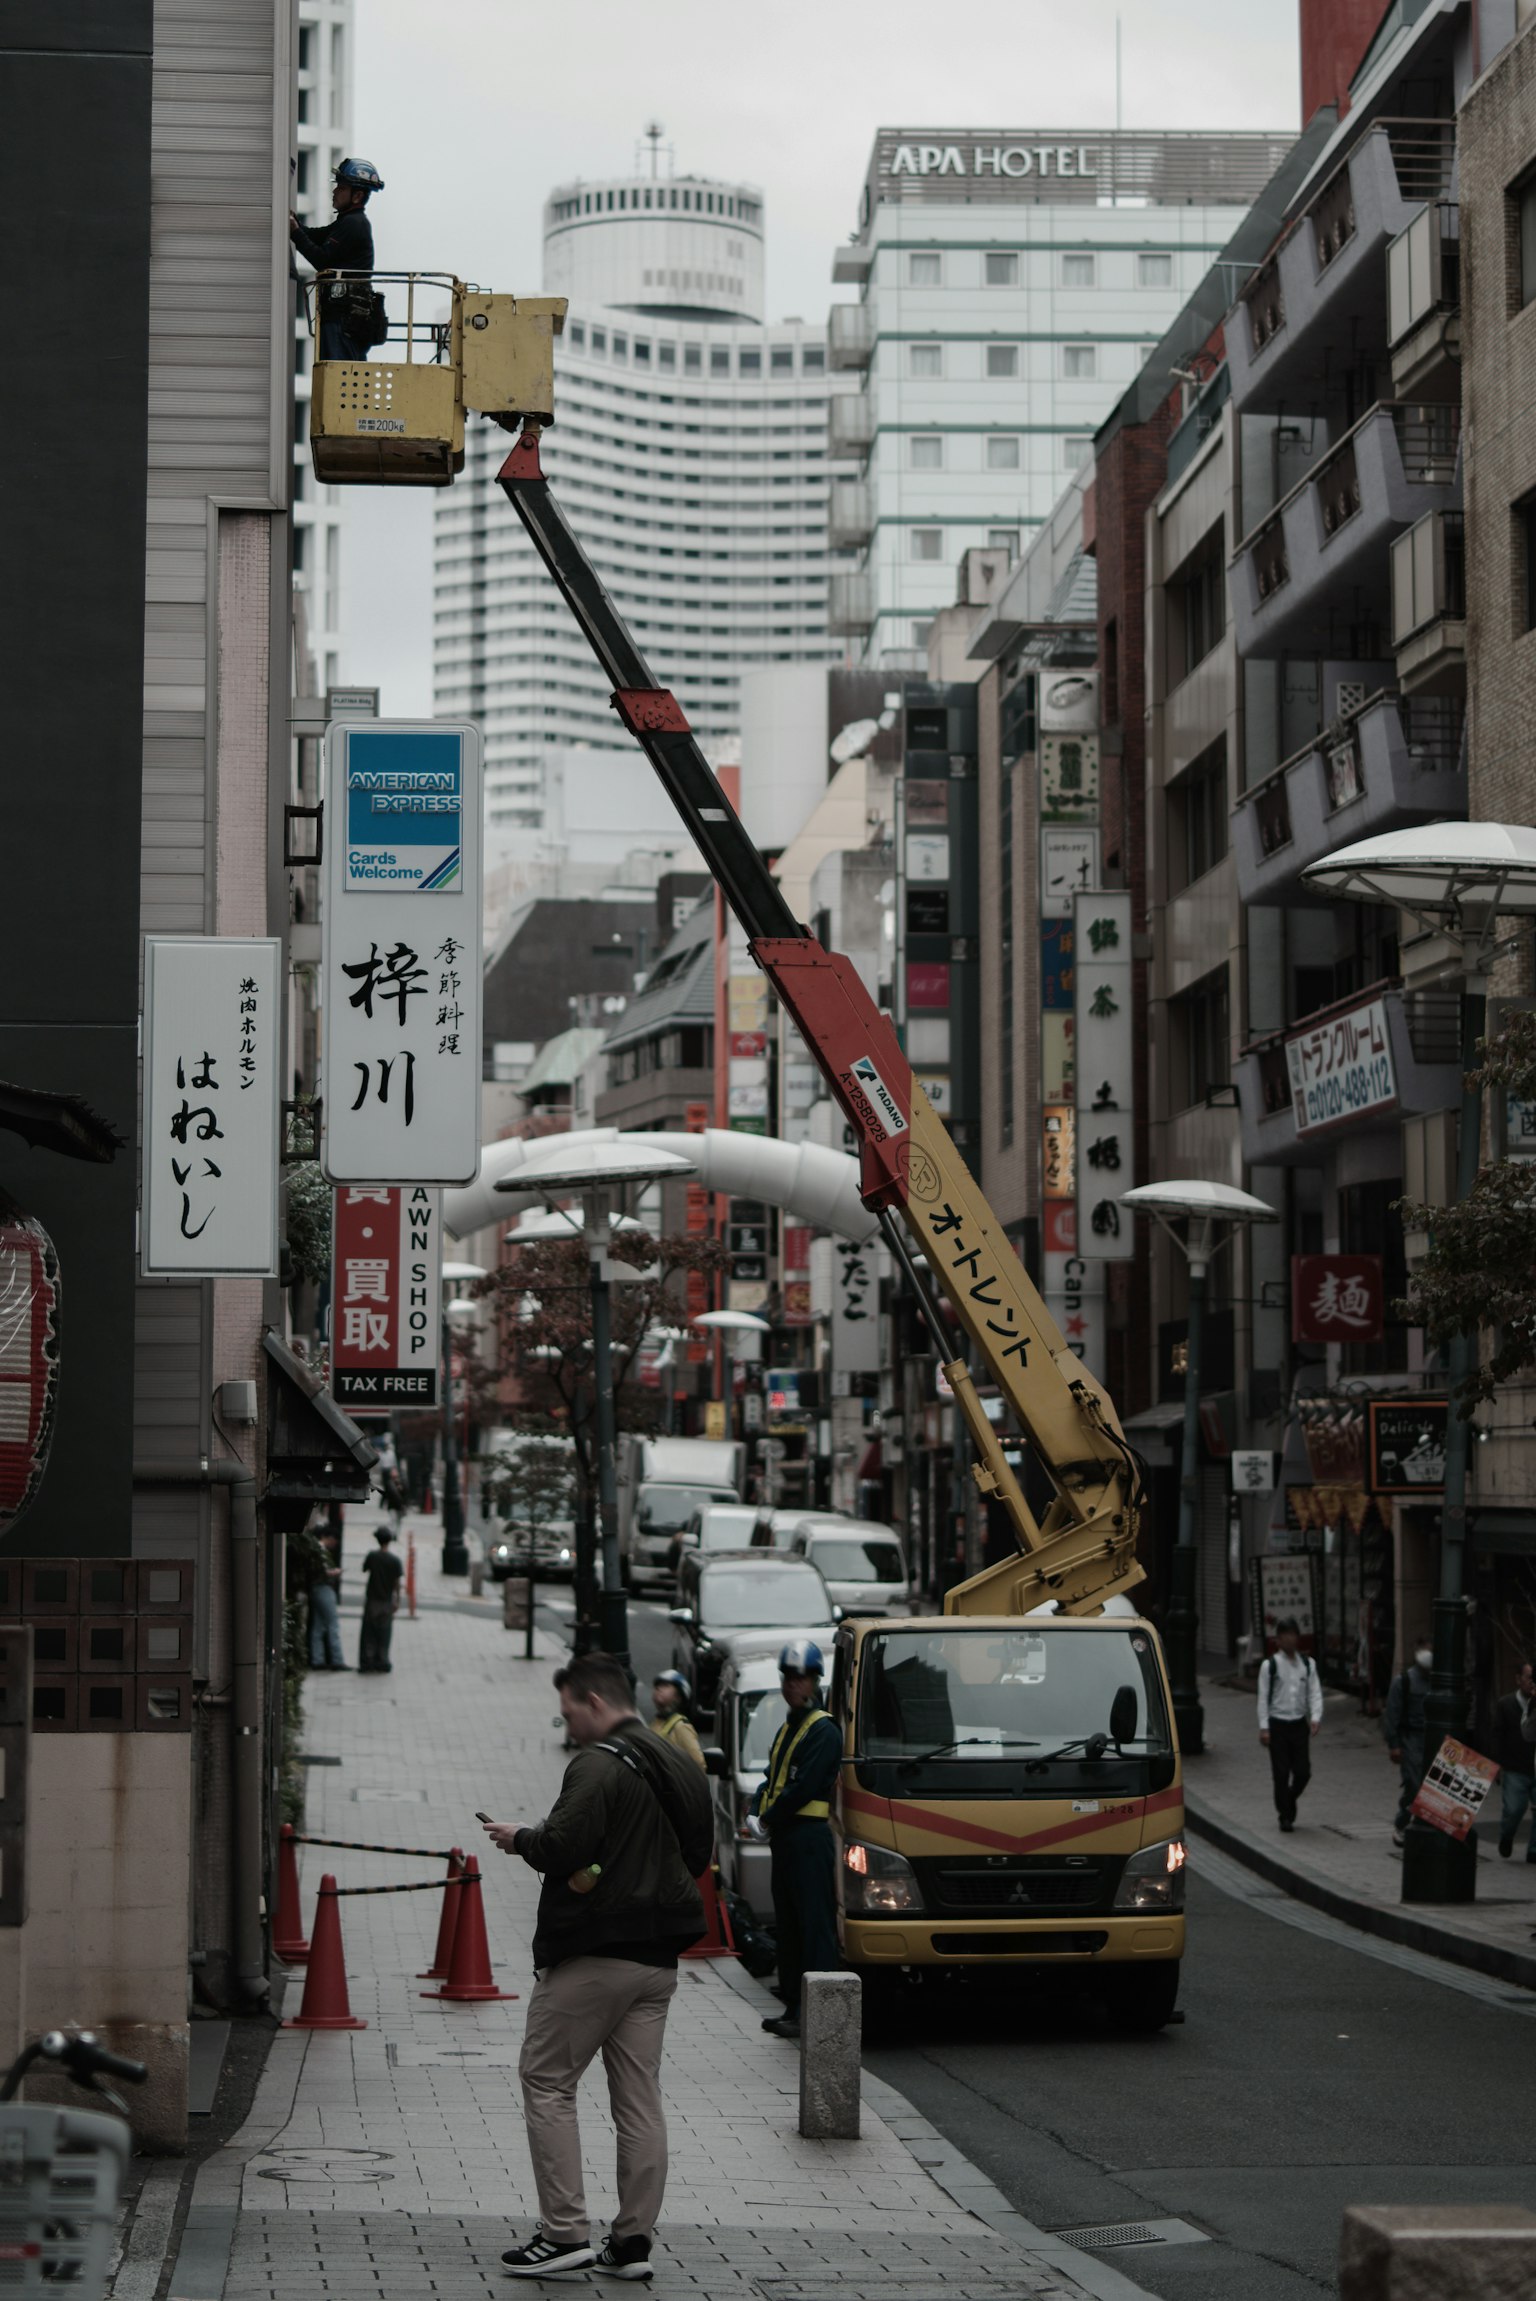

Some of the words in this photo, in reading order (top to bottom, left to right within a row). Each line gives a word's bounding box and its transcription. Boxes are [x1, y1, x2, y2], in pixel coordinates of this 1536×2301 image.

[890, 145, 967, 176] APA
[973, 146, 1098, 177] HOTEL
[376, 420, 405, 432] 200kg
[348, 772, 455, 791] AMERICAN
[372, 794, 463, 814] EXPRESS
[348, 851, 397, 865] Cards
[349, 866, 424, 879] Welcome
[434, 937, 465, 1055] 季節料理
[238, 977, 259, 1089] 焼肉ホルモン
[341, 942, 429, 1127] 梓川
[1301, 1008, 1385, 1080] トランクルーム
[839, 1072, 887, 1143] A-12SB028
[876, 1085, 904, 1128] TADANO
[170, 1051, 224, 1239] はねいし
[409, 1263, 428, 1354] SHOP
[929, 1203, 1032, 1368] オートレント
[1309, 1270, 1372, 1327] 麺
[341, 1377, 382, 1391] TAX
[383, 1377, 428, 1391] FREE
